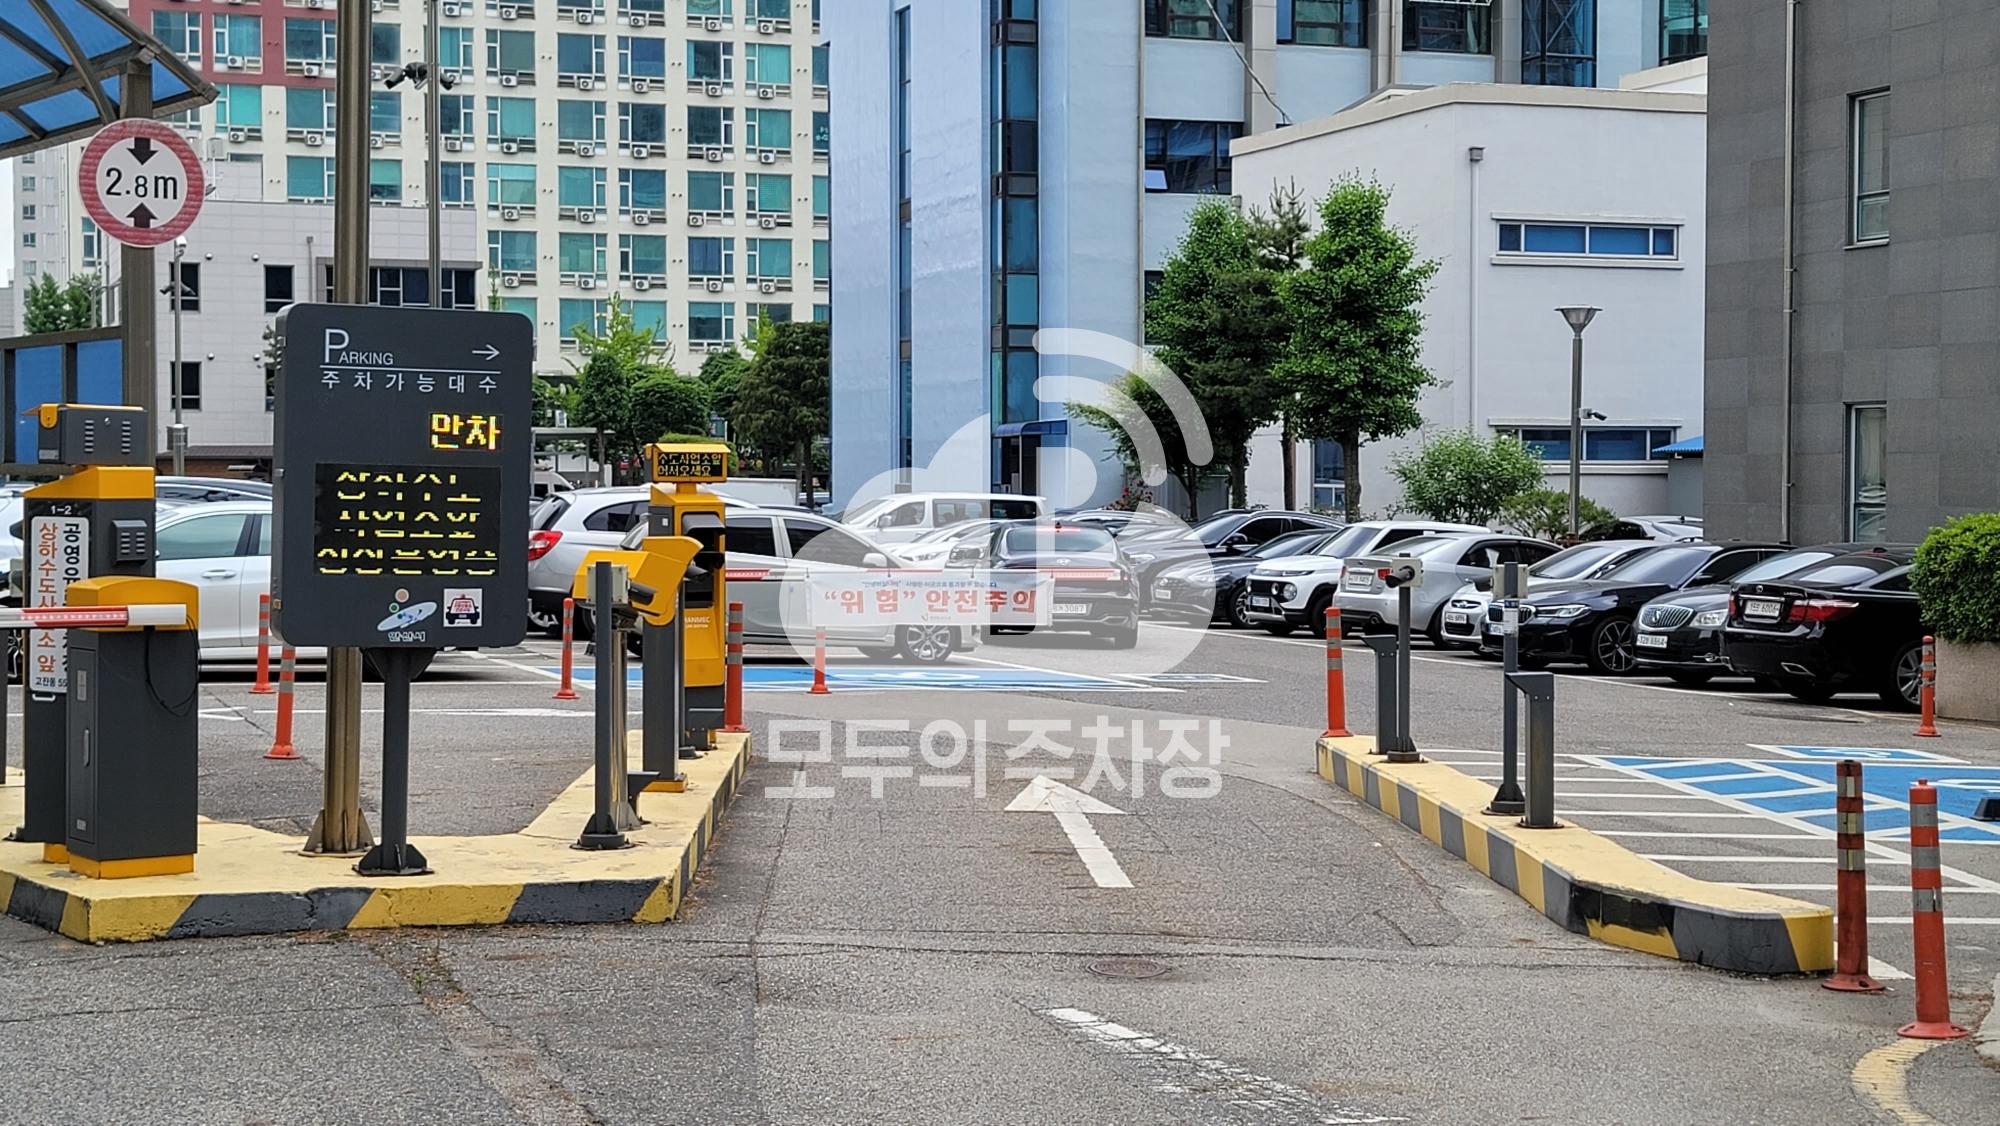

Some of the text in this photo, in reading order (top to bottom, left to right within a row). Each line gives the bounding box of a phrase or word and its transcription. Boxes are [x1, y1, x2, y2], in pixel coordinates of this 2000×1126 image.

[105, 167, 178, 200] 2.8m
[324, 328, 394, 366] PARKING
[321, 371, 497, 394] 주차가능대수
[431, 413, 501, 450] 만차
[658, 465, 712, 476] 어서오세요
[51, 504, 73, 516] 1-2
[926, 588, 1037, 614] 안전주의
